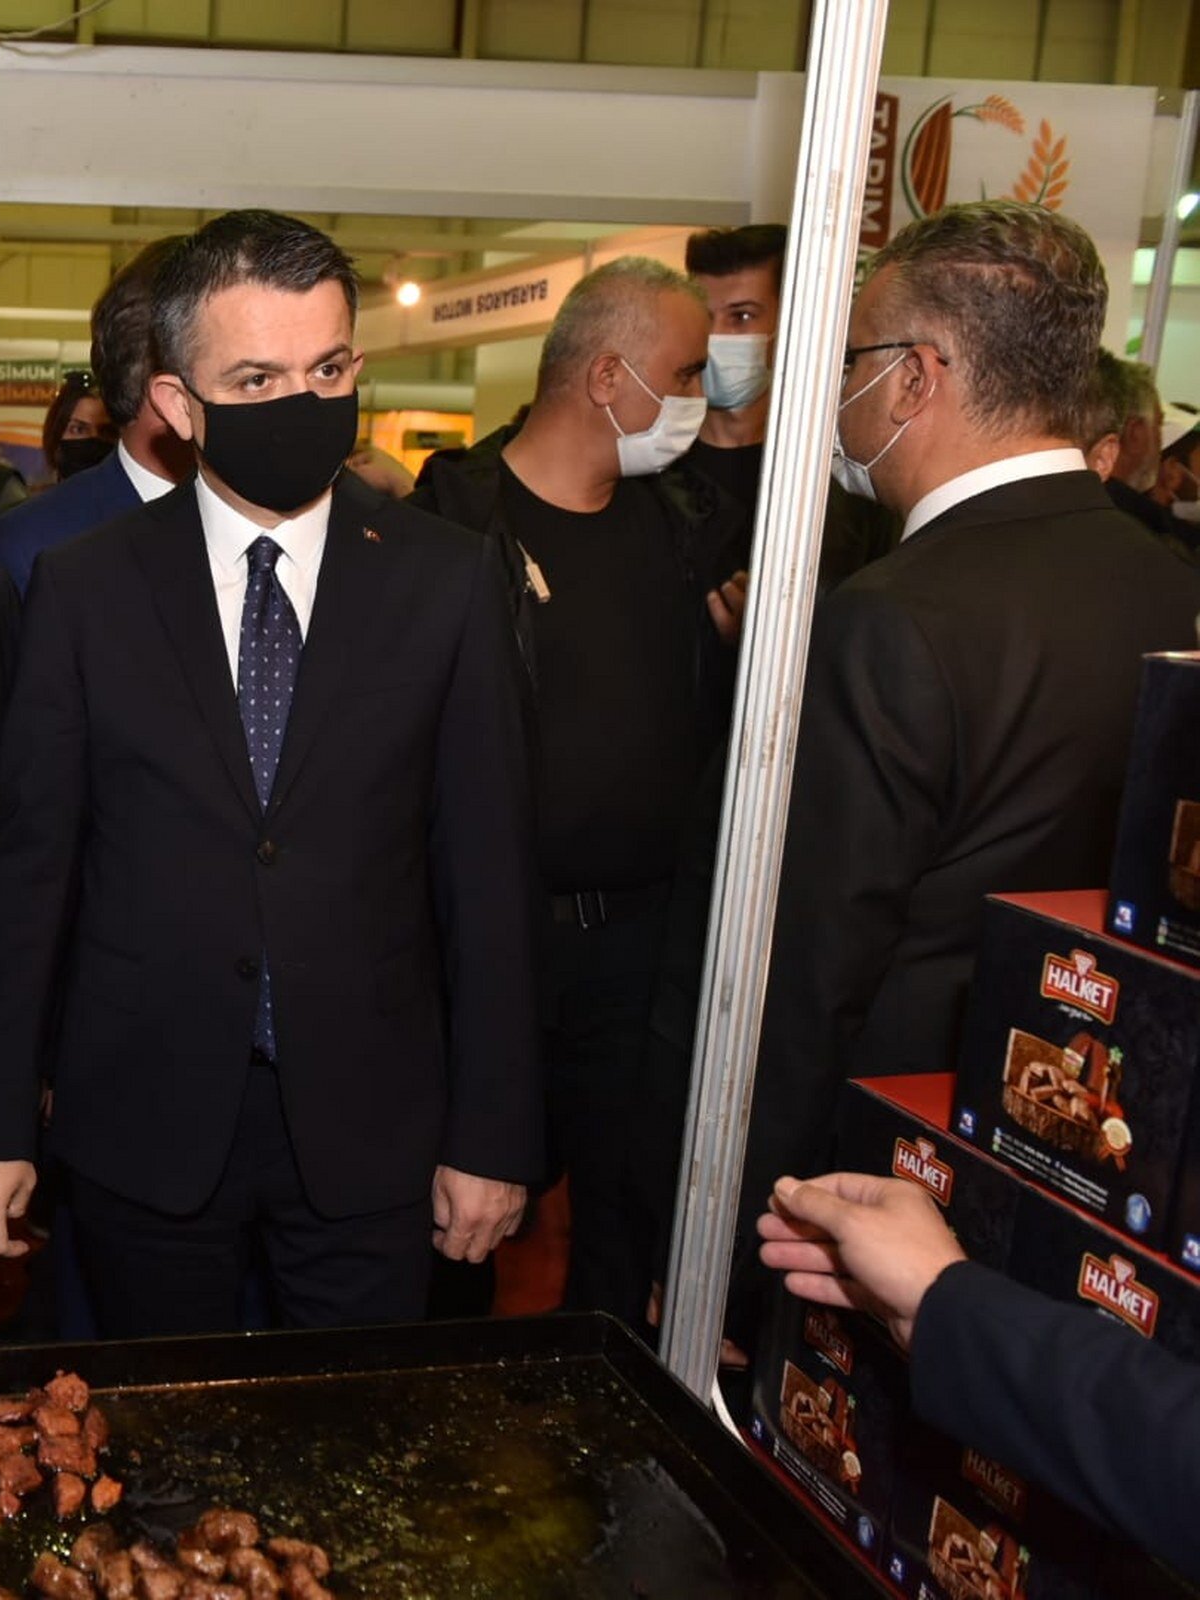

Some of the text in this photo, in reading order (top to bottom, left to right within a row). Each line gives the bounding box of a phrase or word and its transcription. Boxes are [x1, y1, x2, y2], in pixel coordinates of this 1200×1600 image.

[1046, 963, 1113, 1009] HALKET
[897, 1146, 949, 1192] HALKET
[1084, 1264, 1153, 1321] HALKET
[806, 1314, 849, 1362] HALKET
